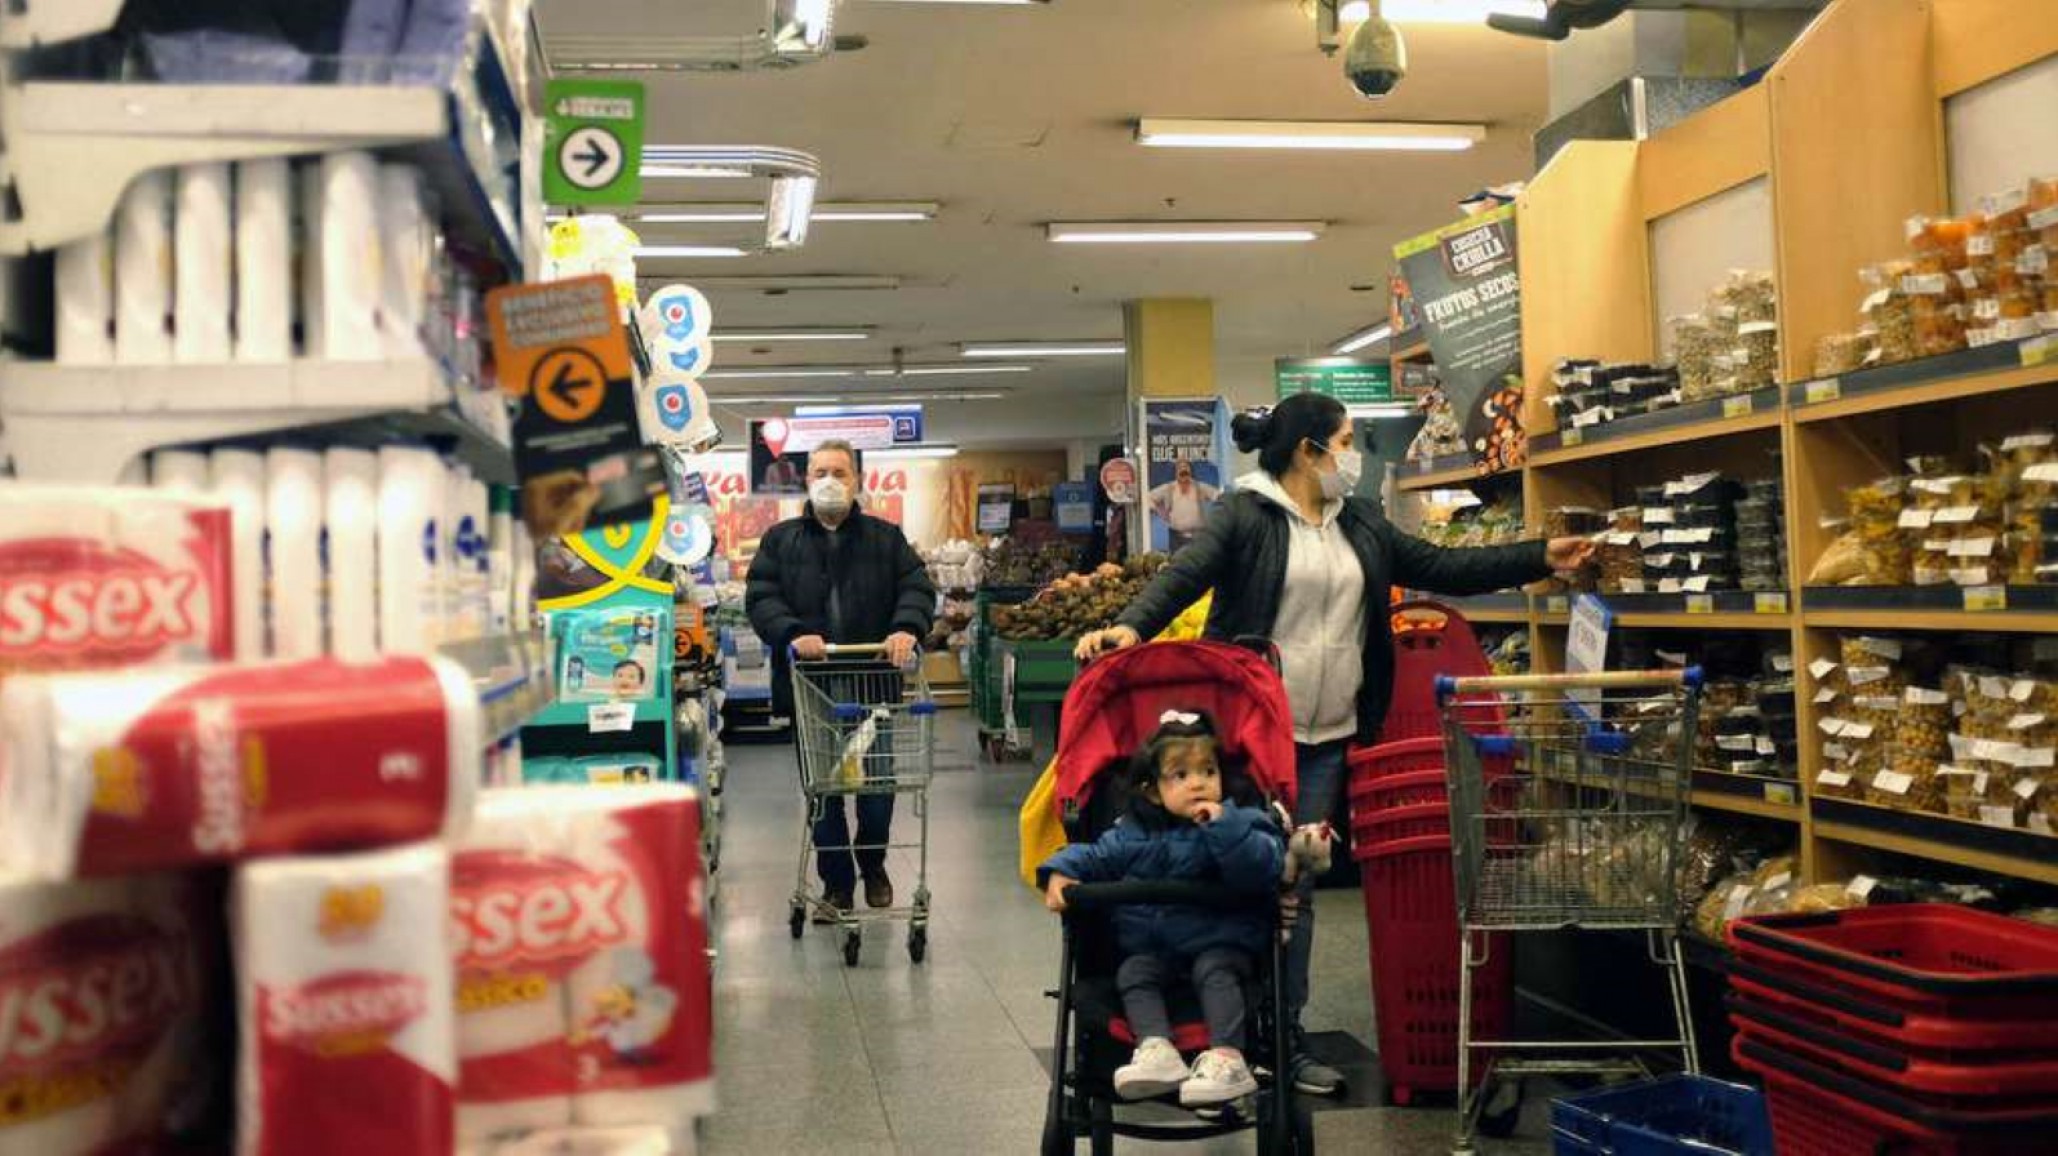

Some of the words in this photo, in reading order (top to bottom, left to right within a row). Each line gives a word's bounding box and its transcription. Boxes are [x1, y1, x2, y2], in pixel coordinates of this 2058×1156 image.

[1423, 288, 1479, 324] FRUTOS
[1476, 271, 1520, 302] SECOS
[1152, 446, 1175, 462] QUE
